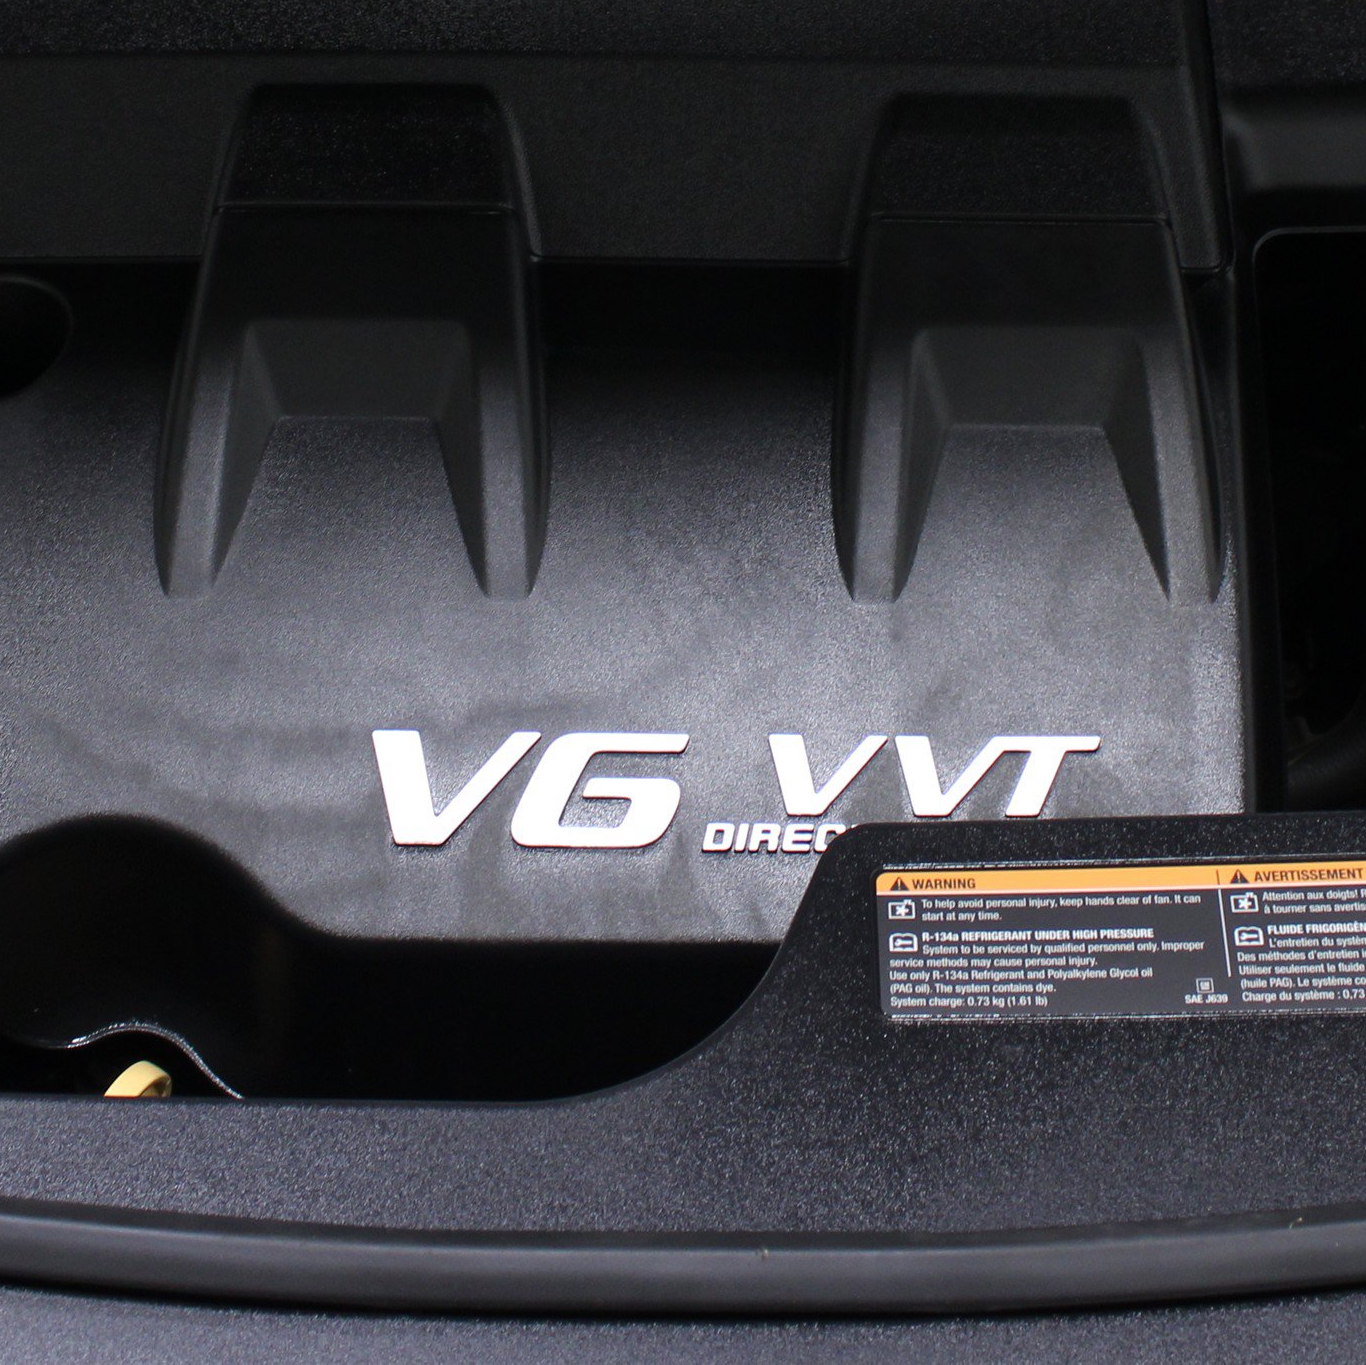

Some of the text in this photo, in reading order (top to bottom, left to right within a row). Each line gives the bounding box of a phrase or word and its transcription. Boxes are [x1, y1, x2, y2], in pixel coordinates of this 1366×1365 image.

[371, 729, 1101, 849] V6 VVT
[702, 822, 857, 853] DIREC
[1254, 868, 1364, 882] AVERTISSEMENT
[913, 879, 976, 889] WARNING
[1263, 890, 1304, 901] Attention
[1307, 891, 1324, 899] aux
[1327, 889, 1358, 901] doigts!
[922, 895, 1201, 910] To help avoid personal injury, keep hands clear of fan. It can
[1264, 904, 1270, 914] à
[1273, 904, 1307, 913] tourner
[1309, 904, 1332, 912] sans
[922, 911, 1002, 922] start at any time.
[1267, 923, 1303, 934] FLUIDE
[922, 928, 1154, 942] R-134a REFRIGERANT UNDER HIGH PRESSURE
[922, 941, 1205, 956] System to be serviced by qualified personnel only. Improper
[890, 956, 1097, 968] service methods may cause personal injury.
[890, 967, 1153, 982] Use only R-134a Refrigerant and Polyalkylene Glycol oil
[890, 983, 1056, 994] (PAG oil). The system contains dye.
[891, 996, 1048, 1008] System charge: 0.73 kg (1.61 lb)
[1185, 994, 1228, 1003] SAE J639
[1242, 992, 1276, 1003] Charge
[1279, 991, 1291, 1000] du
[1294, 990, 1334, 1002] système
[1343, 989, 1365, 999] 0,73
